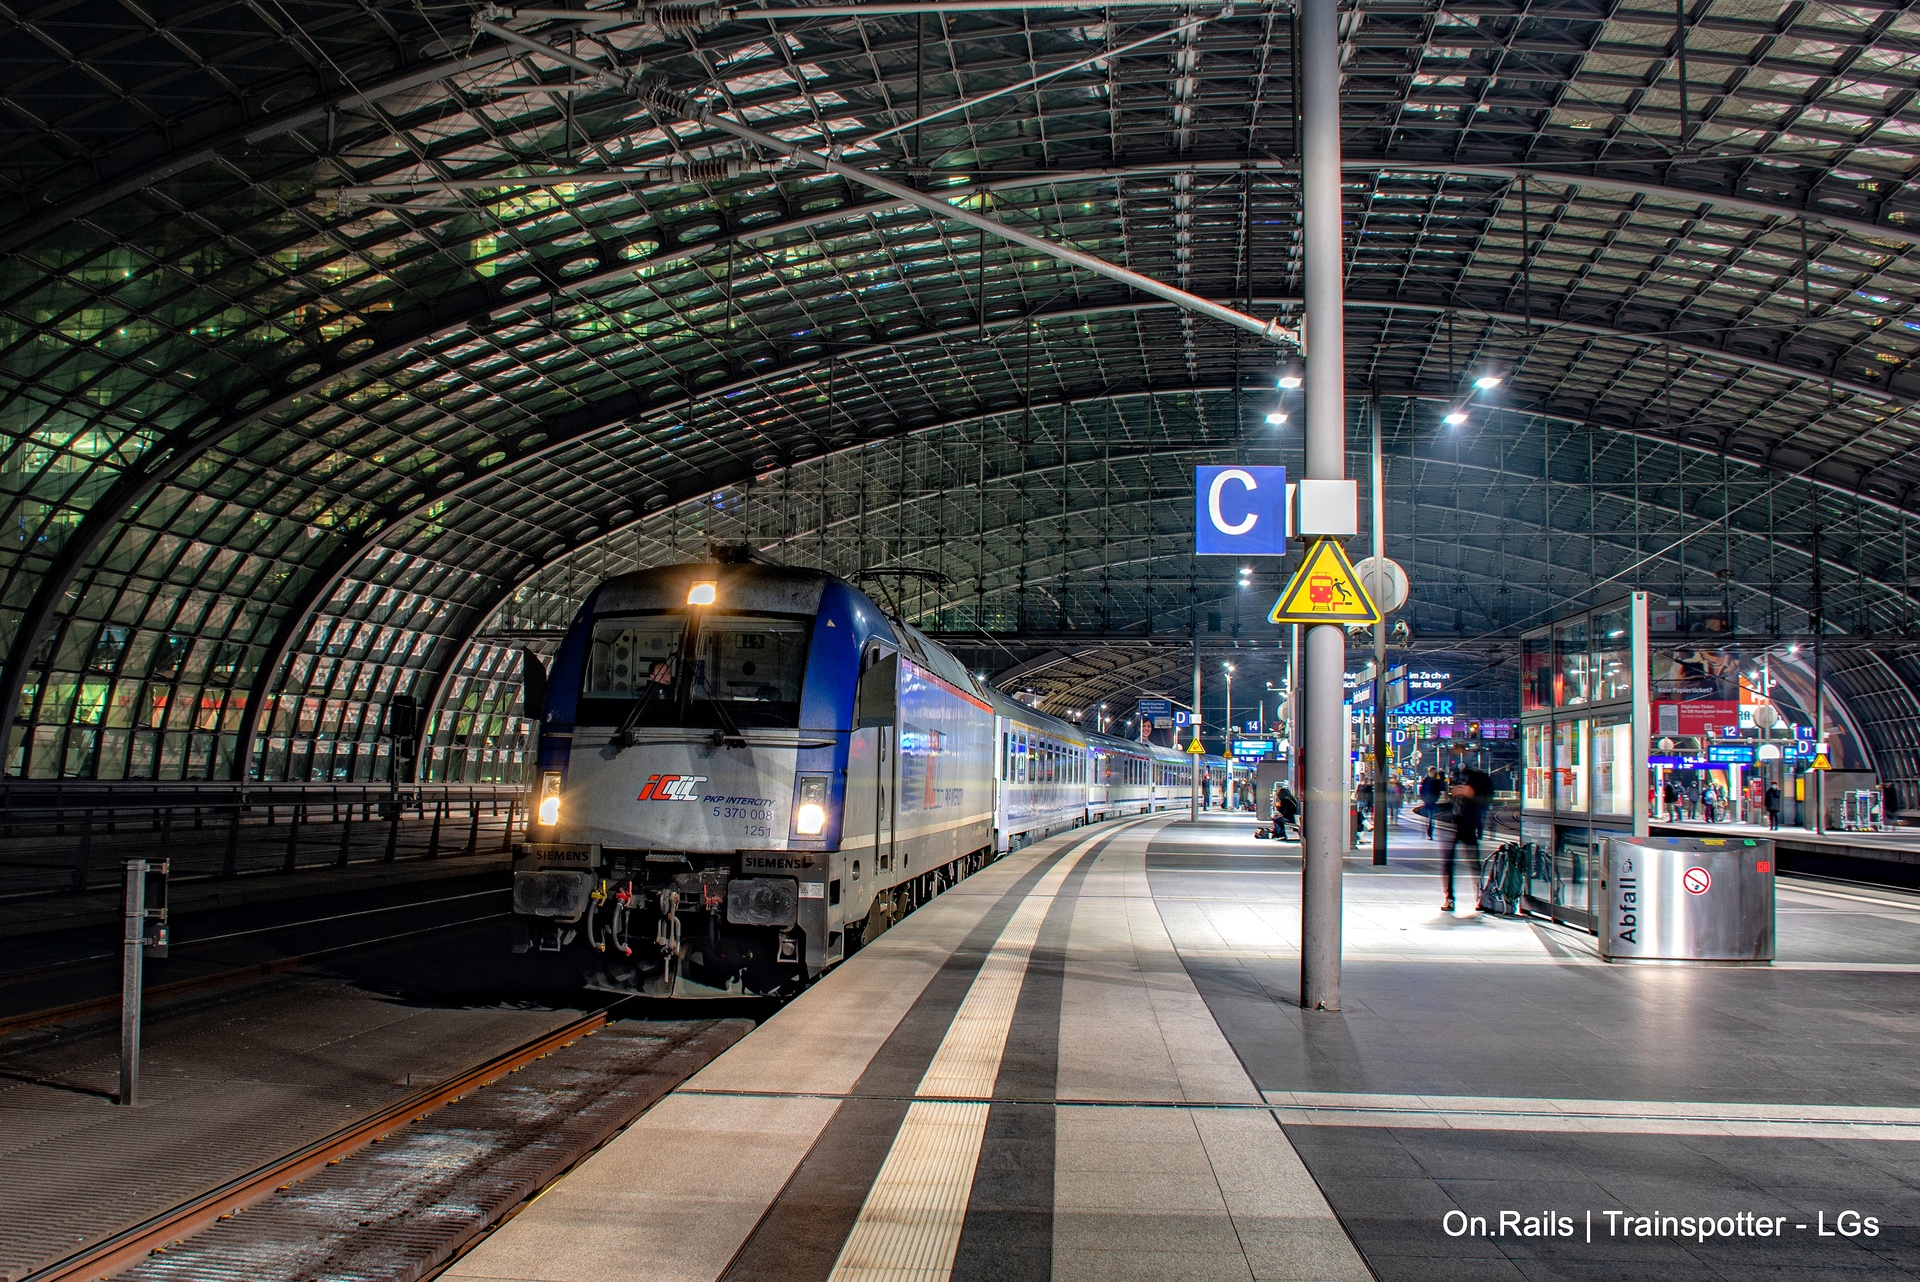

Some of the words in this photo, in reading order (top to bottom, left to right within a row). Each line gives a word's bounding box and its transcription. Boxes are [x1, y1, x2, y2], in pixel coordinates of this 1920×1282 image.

[1208, 469, 1258, 536] C
[1423, 681, 1442, 690] Burg
[1176, 712, 1186, 723] D
[1247, 722, 1258, 731] 14
[1723, 726, 1736, 736] 12
[1802, 727, 1813, 737] 11
[1396, 730, 1406, 743] D
[1798, 742, 1809, 754] D
[703, 795, 724, 803] PKP
[725, 796, 776, 807] INTERCITY
[713, 806, 720, 817] 5
[724, 807, 747, 818] 370
[750, 809, 774, 821] 008
[744, 825, 772, 837] 1251
[536, 849, 589, 862] SIEMENS
[745, 857, 801, 869] SIEMENS
[1757, 862, 1770, 872] DB
[1619, 877, 1637, 944] Abfall
